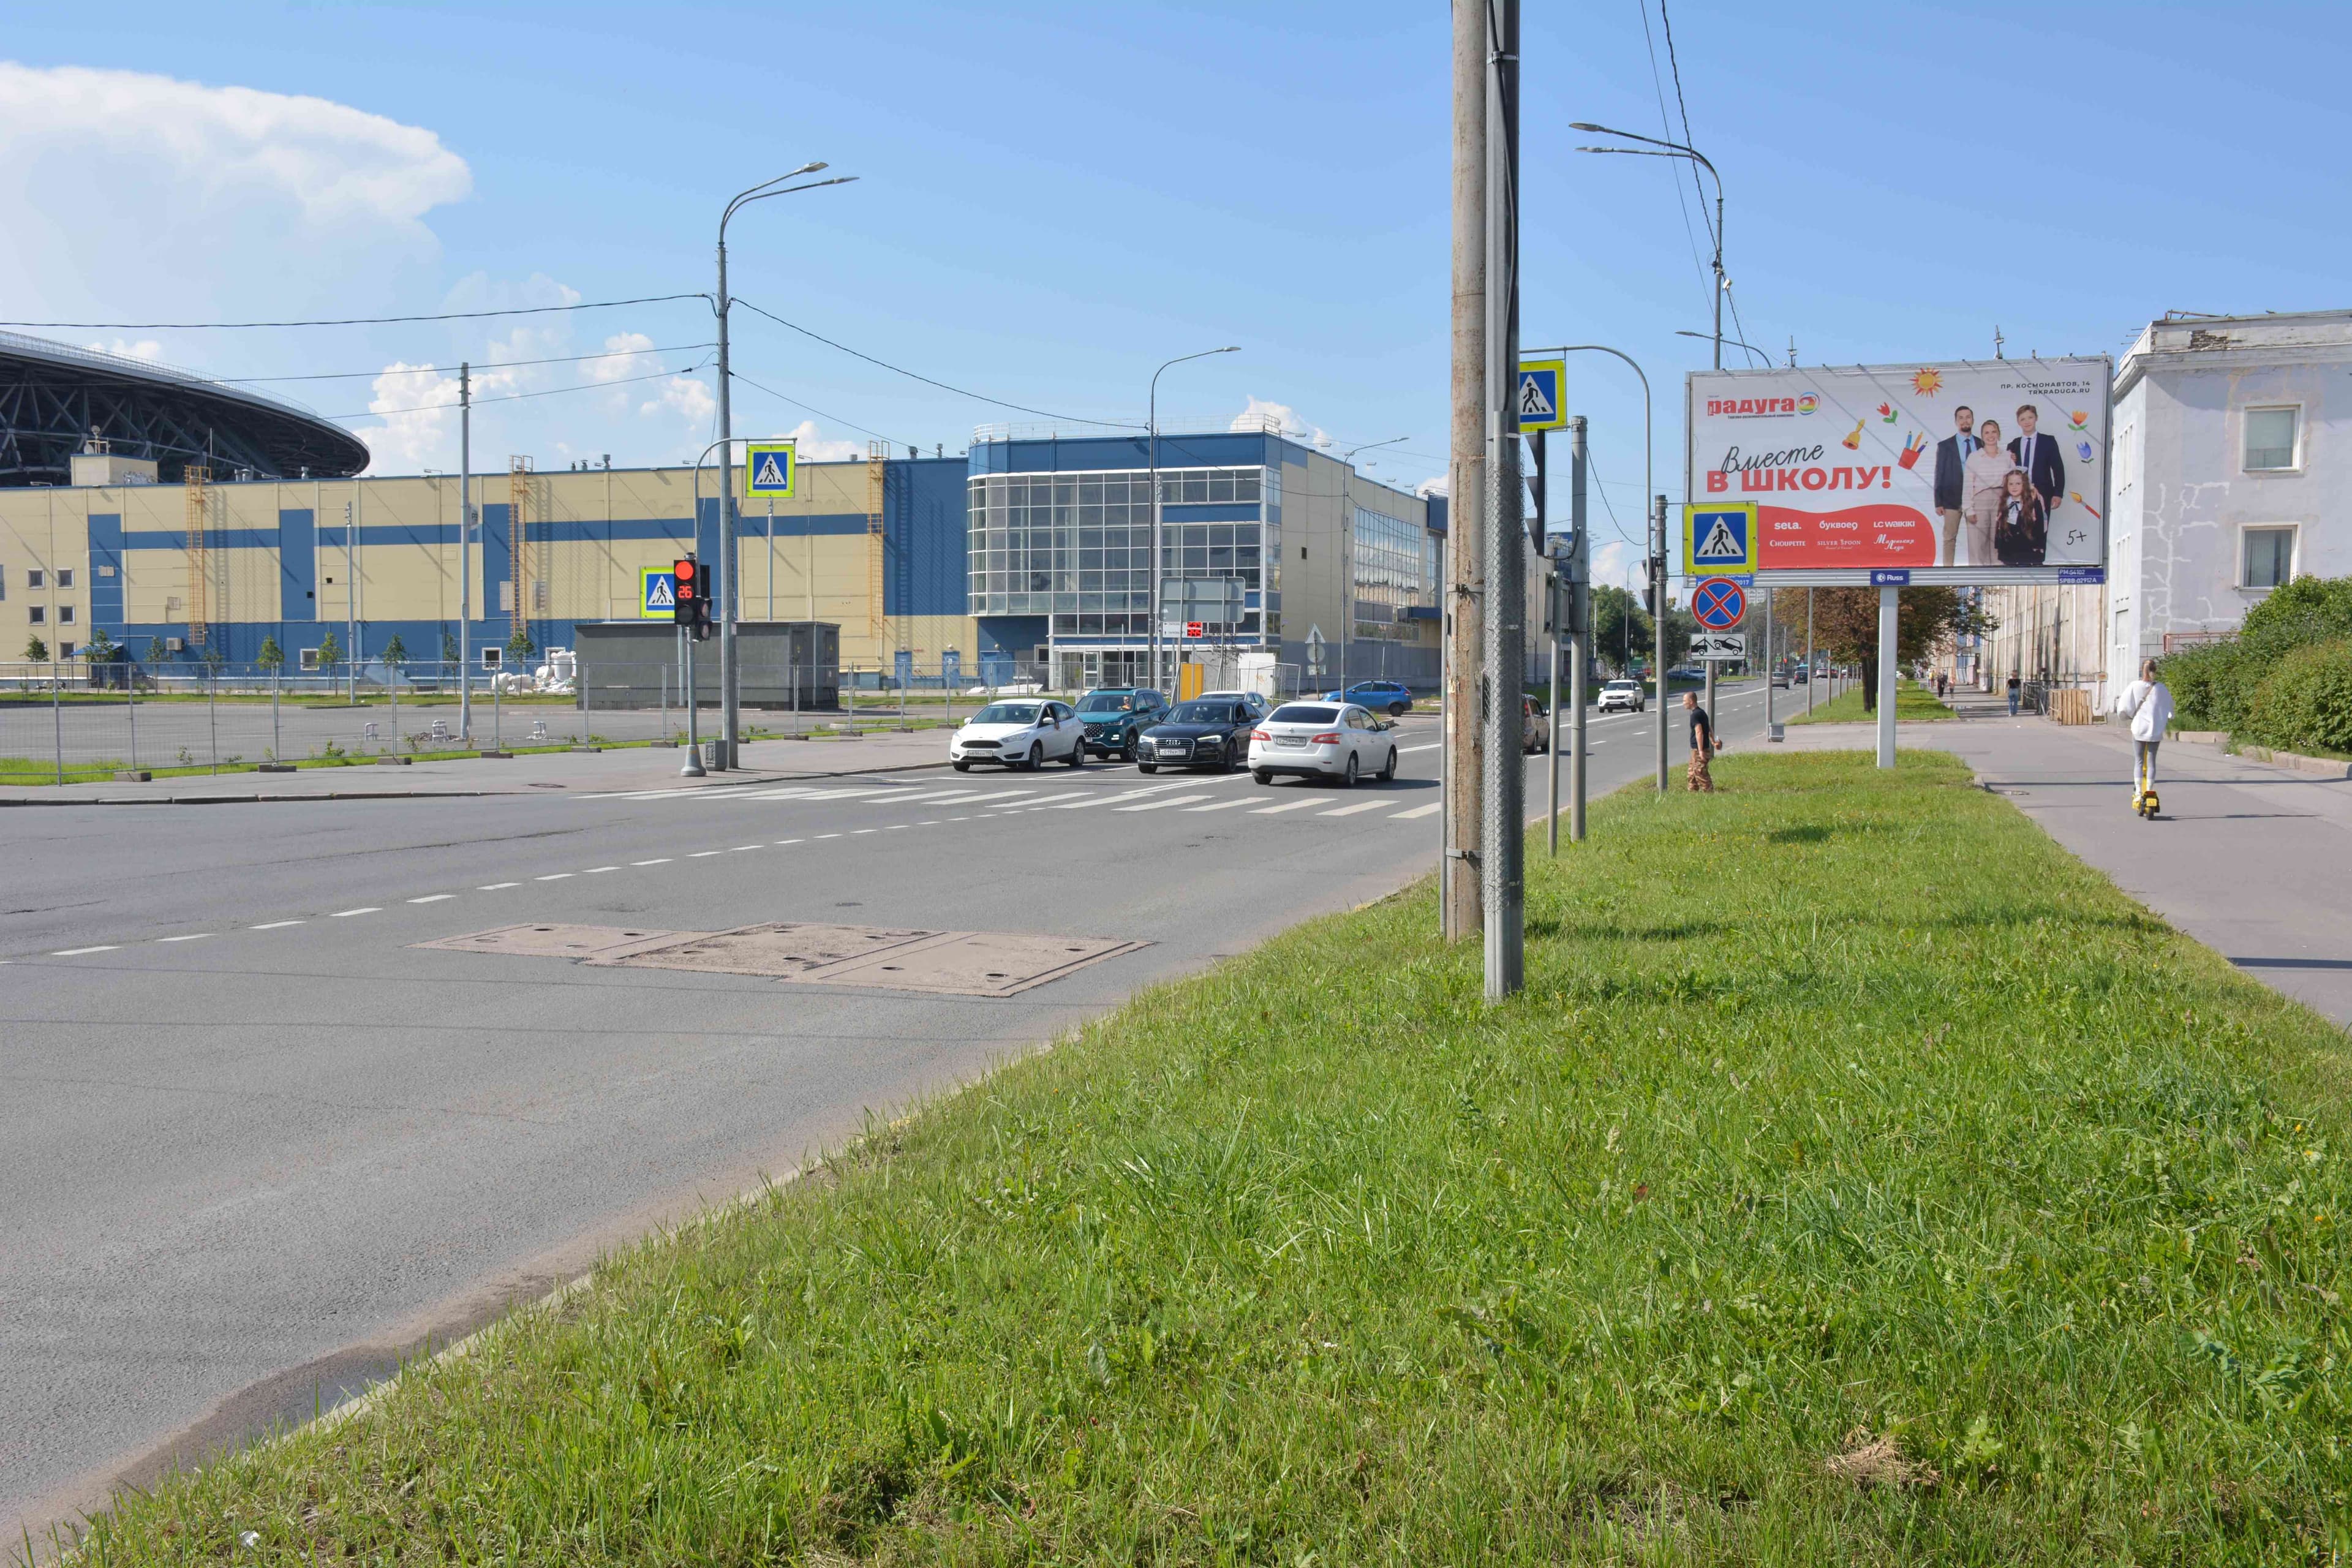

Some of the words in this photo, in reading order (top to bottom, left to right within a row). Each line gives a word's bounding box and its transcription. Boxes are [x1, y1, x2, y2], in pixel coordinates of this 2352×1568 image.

[1721, 445, 1824, 474] Вместе
[1741, 466, 1891, 492] ШКОЛУ!
[2066, 529, 2087, 545] 5+
[678, 585, 693, 598] 26
